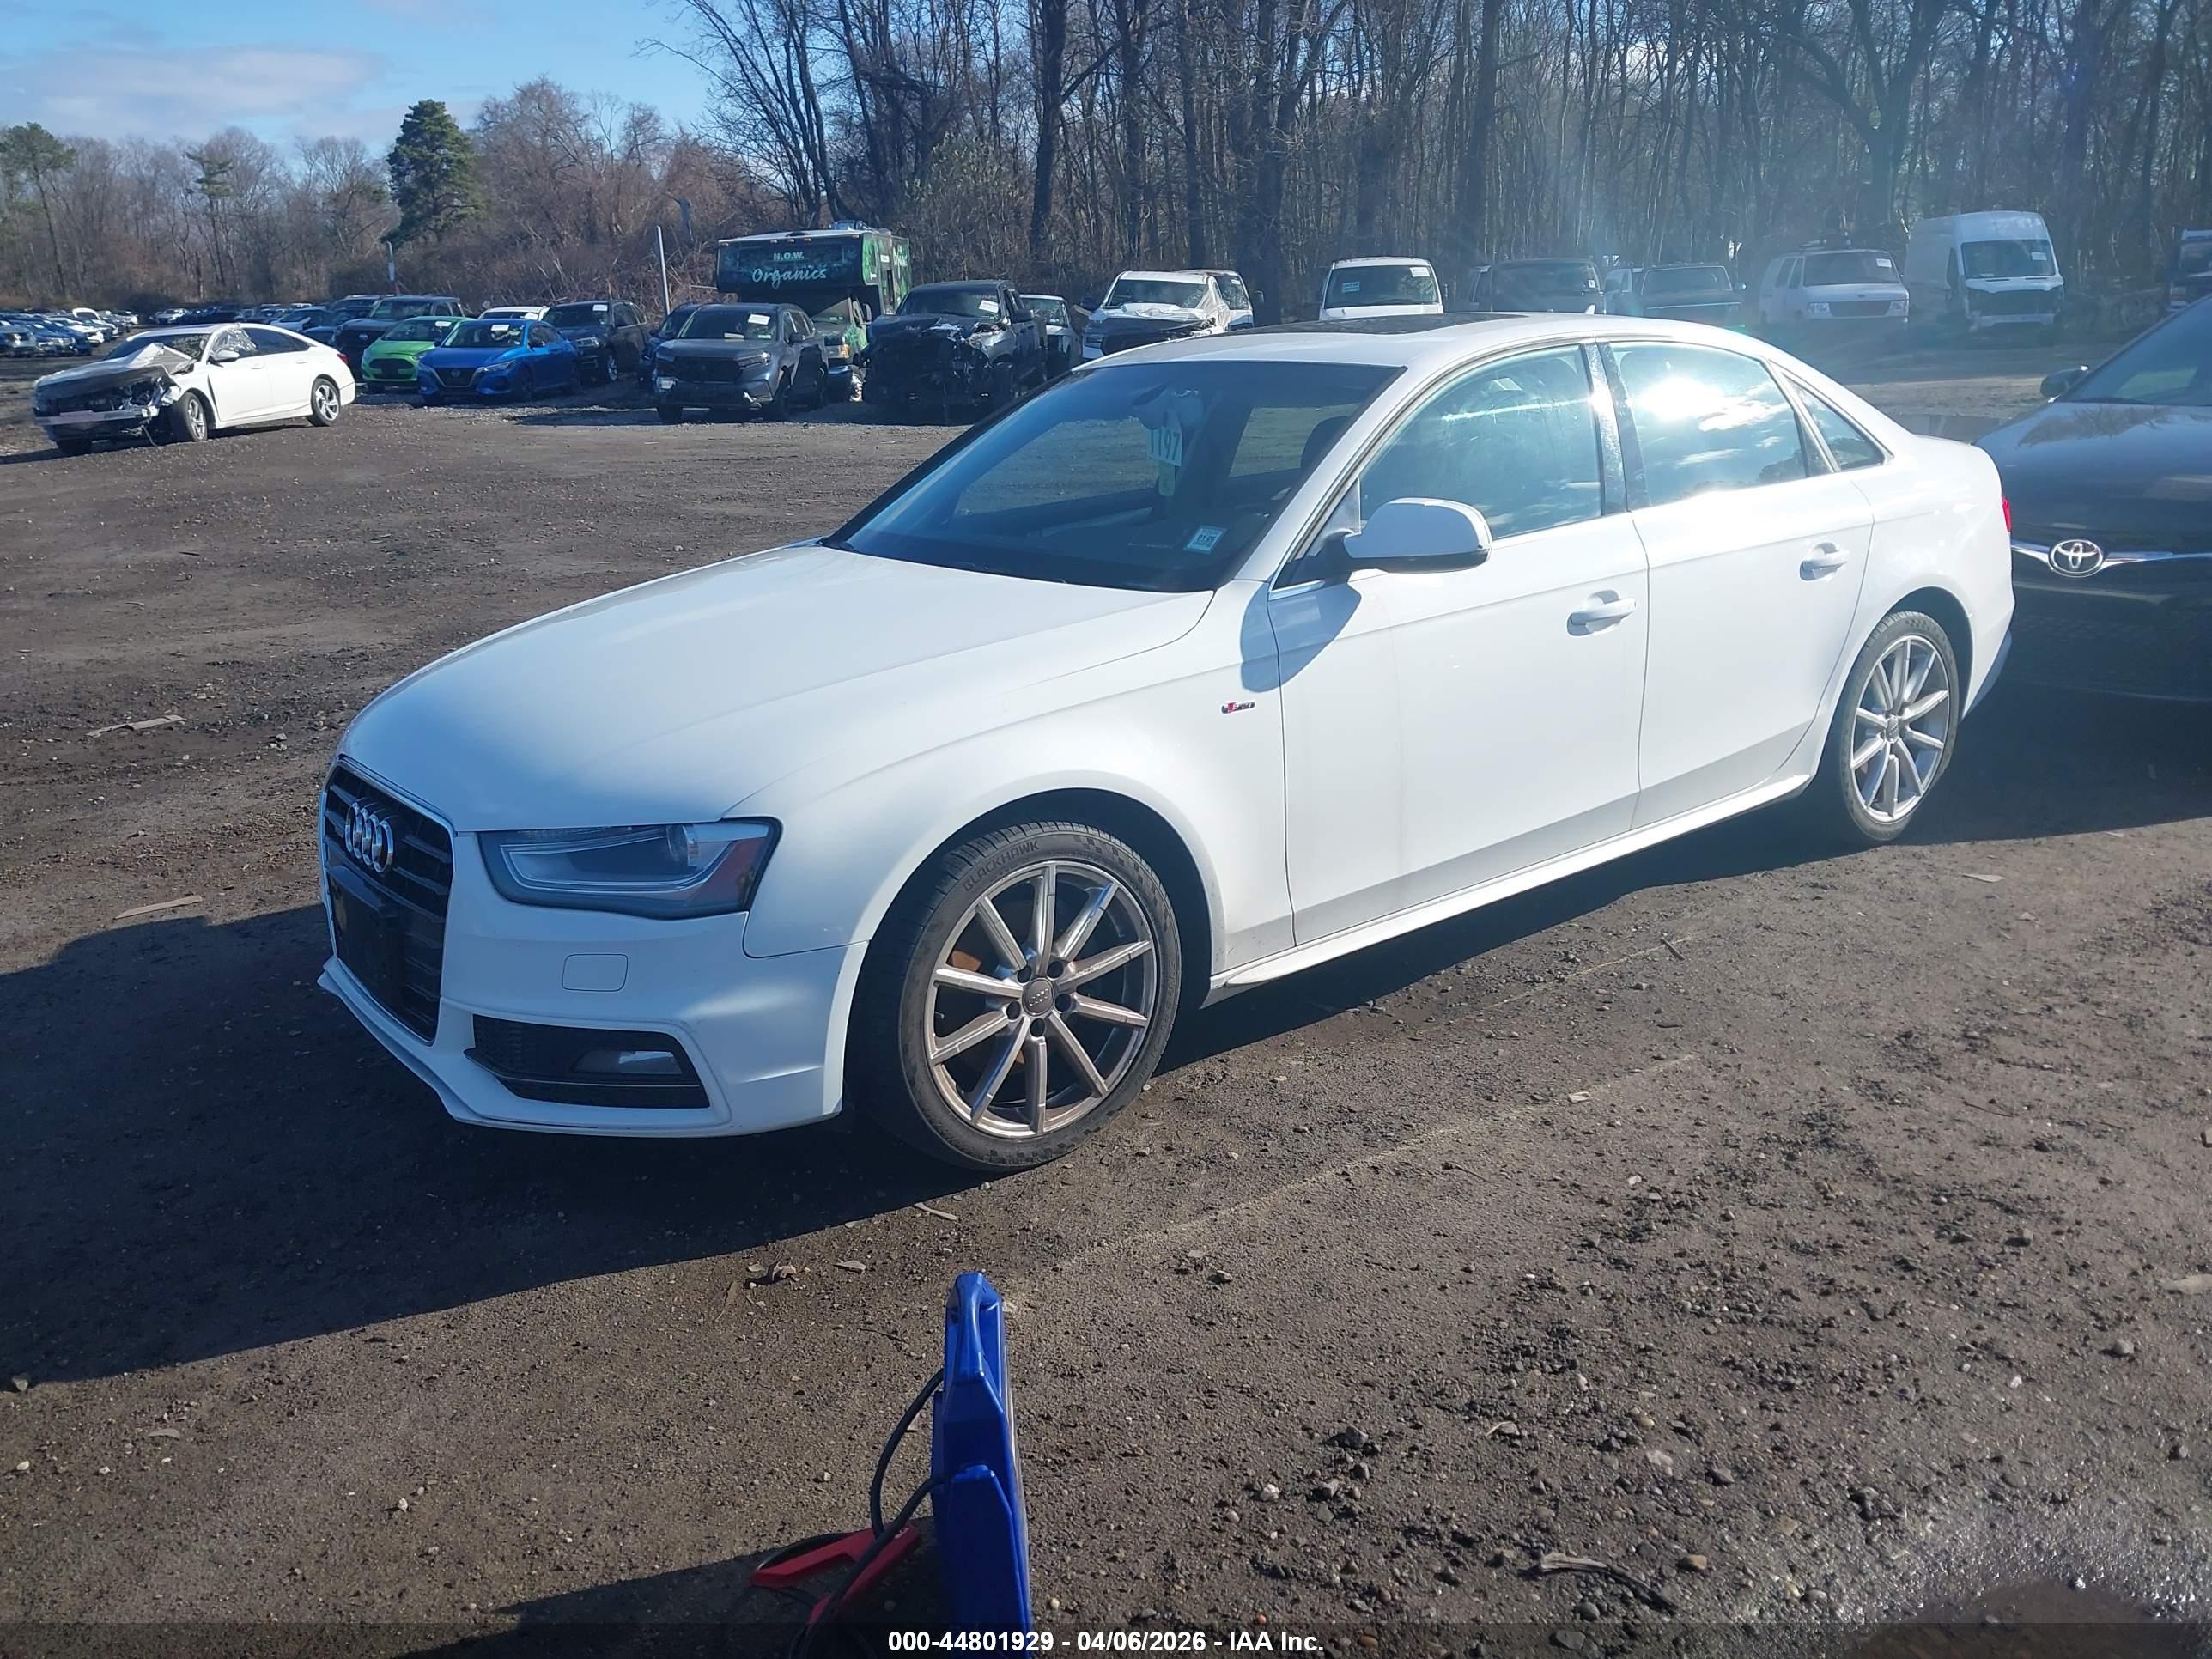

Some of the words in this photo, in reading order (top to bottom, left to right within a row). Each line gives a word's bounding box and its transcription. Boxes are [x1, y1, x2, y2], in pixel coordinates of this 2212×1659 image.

[751, 266, 827, 289] Organics
[1151, 430, 1181, 460] 1197
[963, 840, 1040, 893] BLACKHAWK
